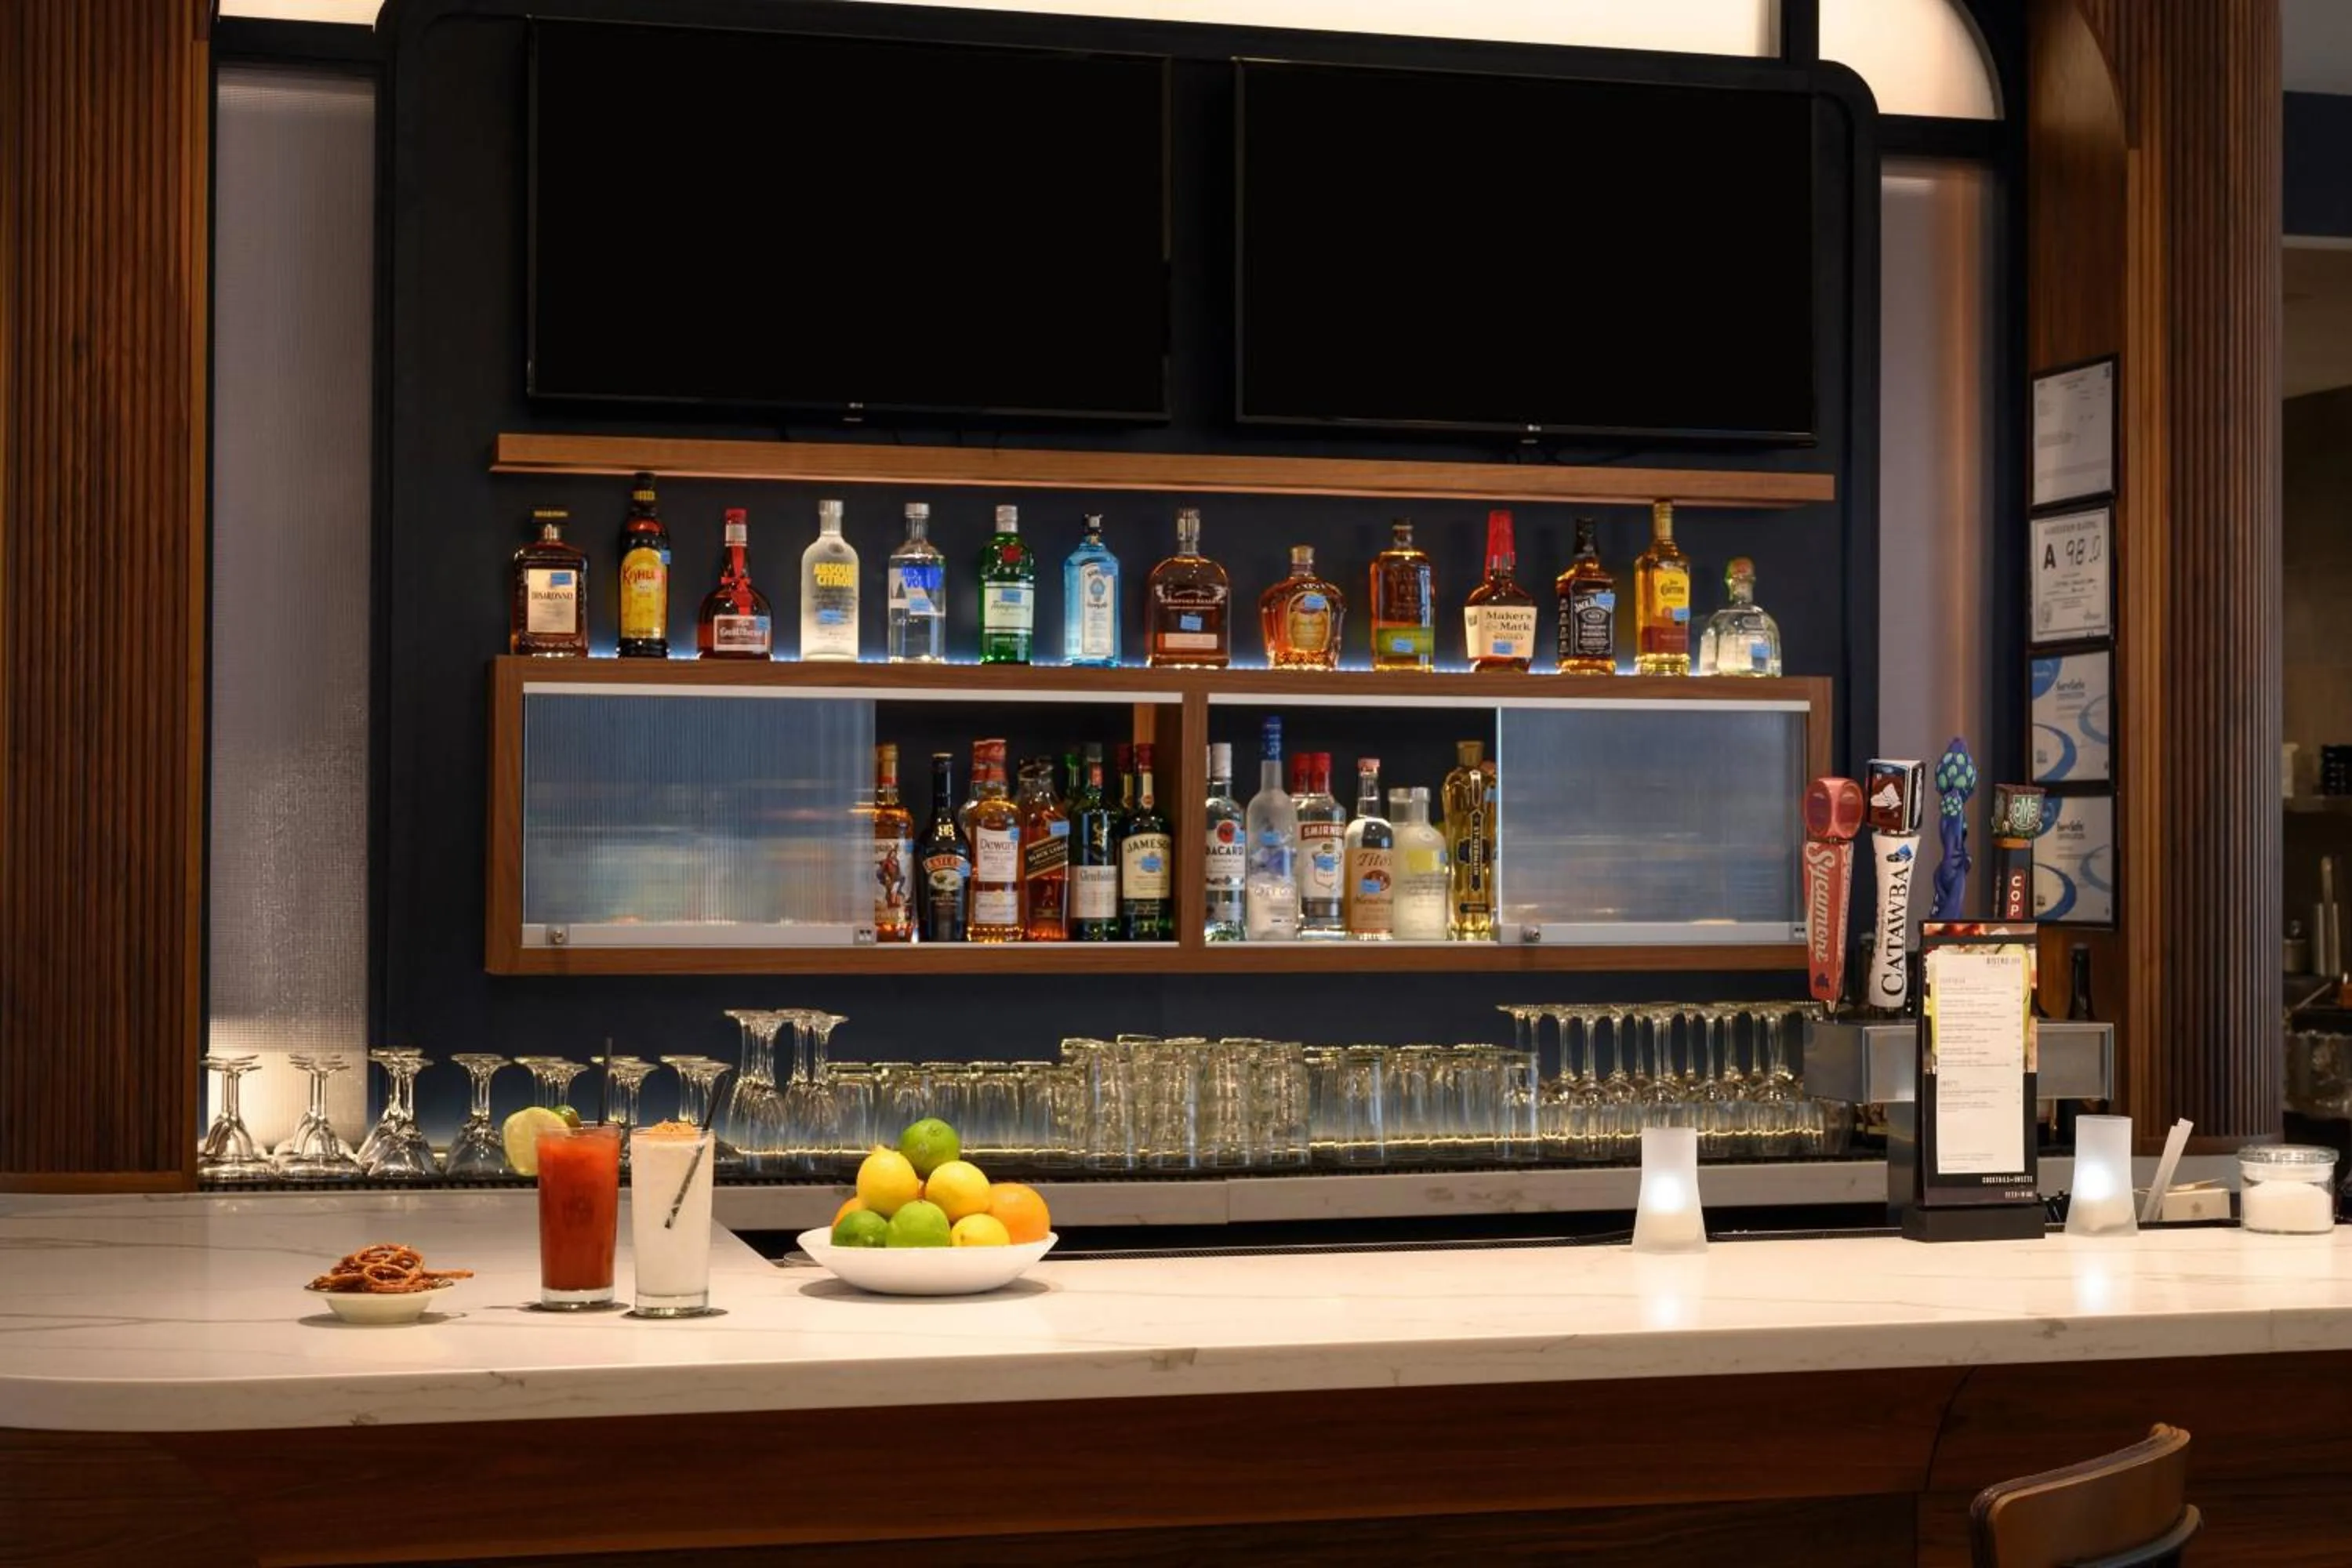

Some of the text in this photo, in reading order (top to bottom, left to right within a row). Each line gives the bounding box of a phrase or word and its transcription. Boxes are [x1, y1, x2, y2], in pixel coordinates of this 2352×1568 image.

[2043, 543, 2056, 570] A
[1806, 841, 1836, 963] Sycamore
[1881, 866, 1909, 996] CATAWBA
[2009, 875, 2022, 916] COP
